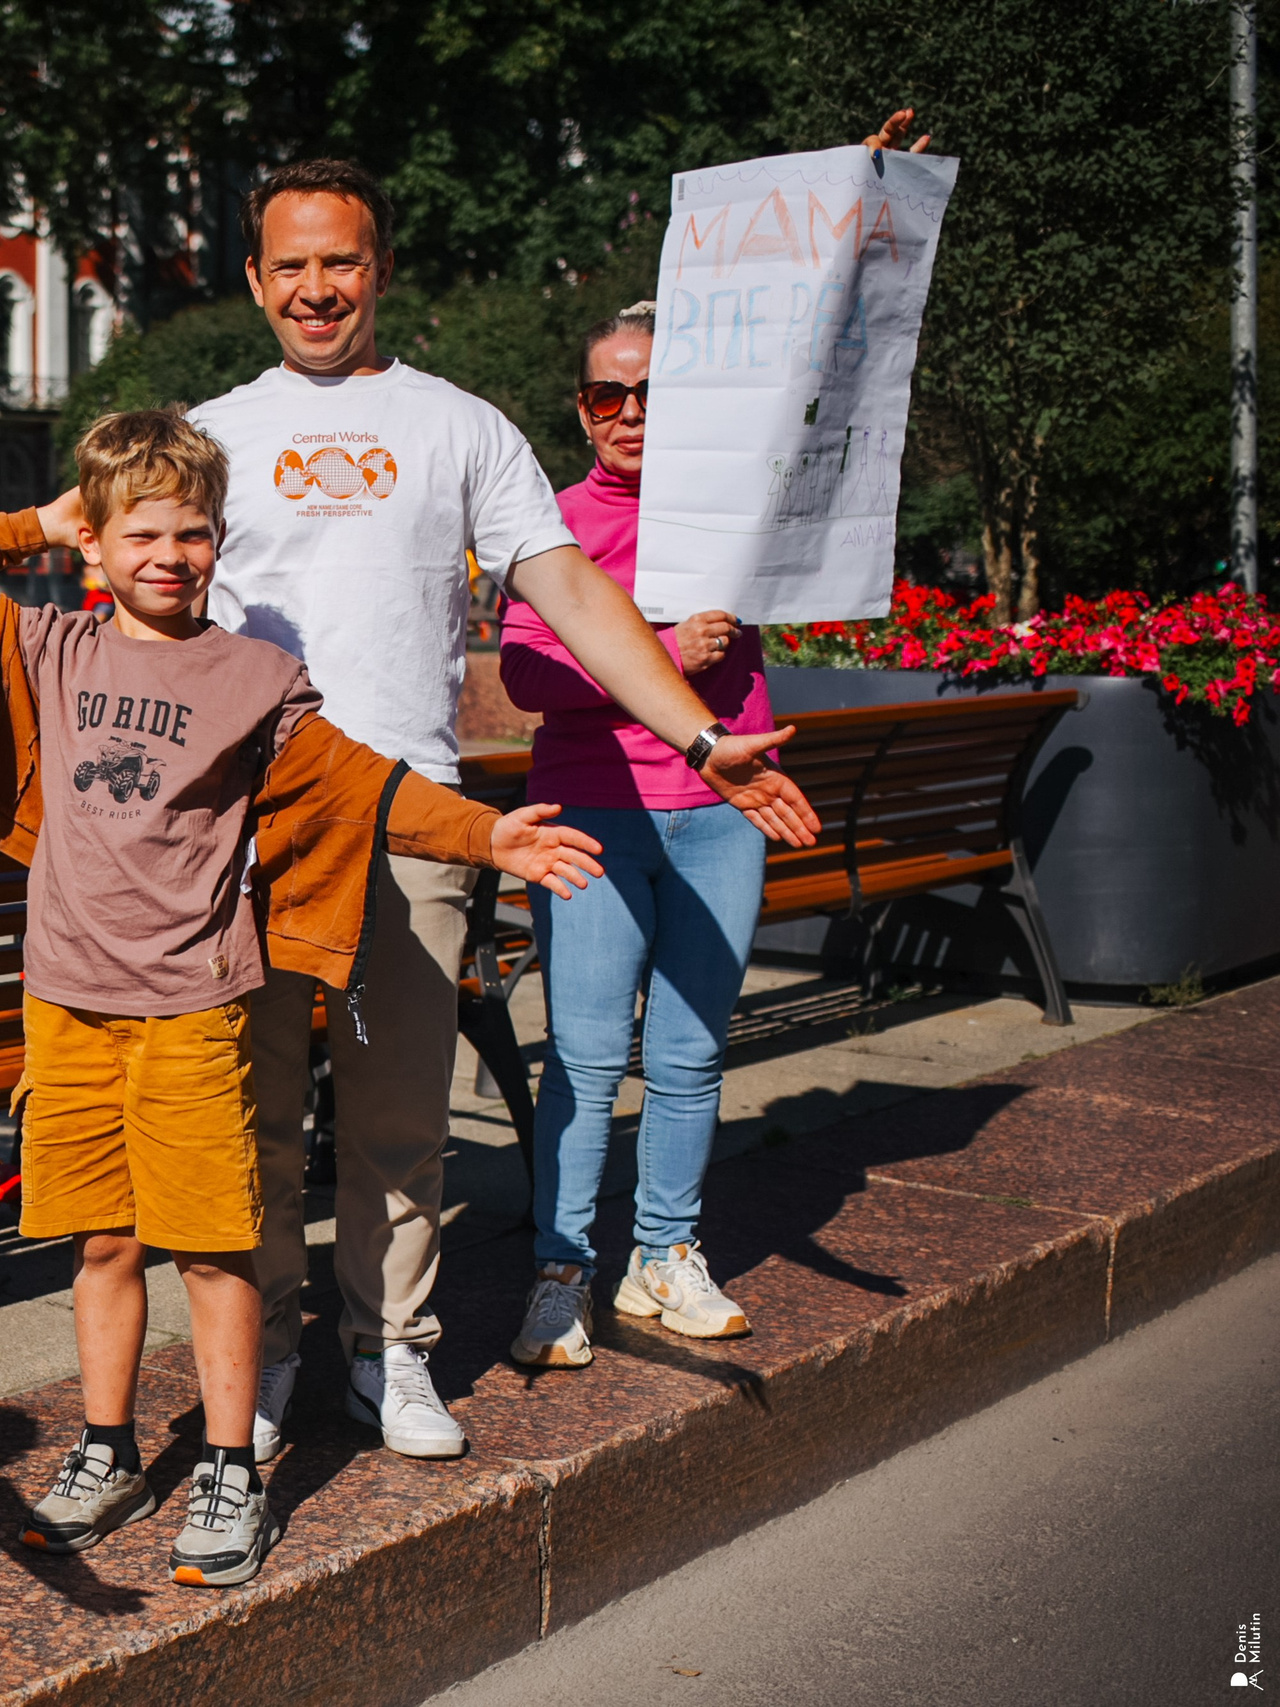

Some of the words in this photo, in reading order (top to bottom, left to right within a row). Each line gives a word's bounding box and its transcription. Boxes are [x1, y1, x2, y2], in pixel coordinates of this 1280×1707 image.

[292, 432, 337, 444] Central
[339, 431, 379, 443] Works
[296, 510, 321, 518] FRESH
[322, 509, 373, 517] PERSPECTIVE
[77, 690, 108, 732] GO
[112, 696, 193, 748] RIDE
[80, 800, 105, 818] BEST
[109, 809, 142, 819] RIDER
